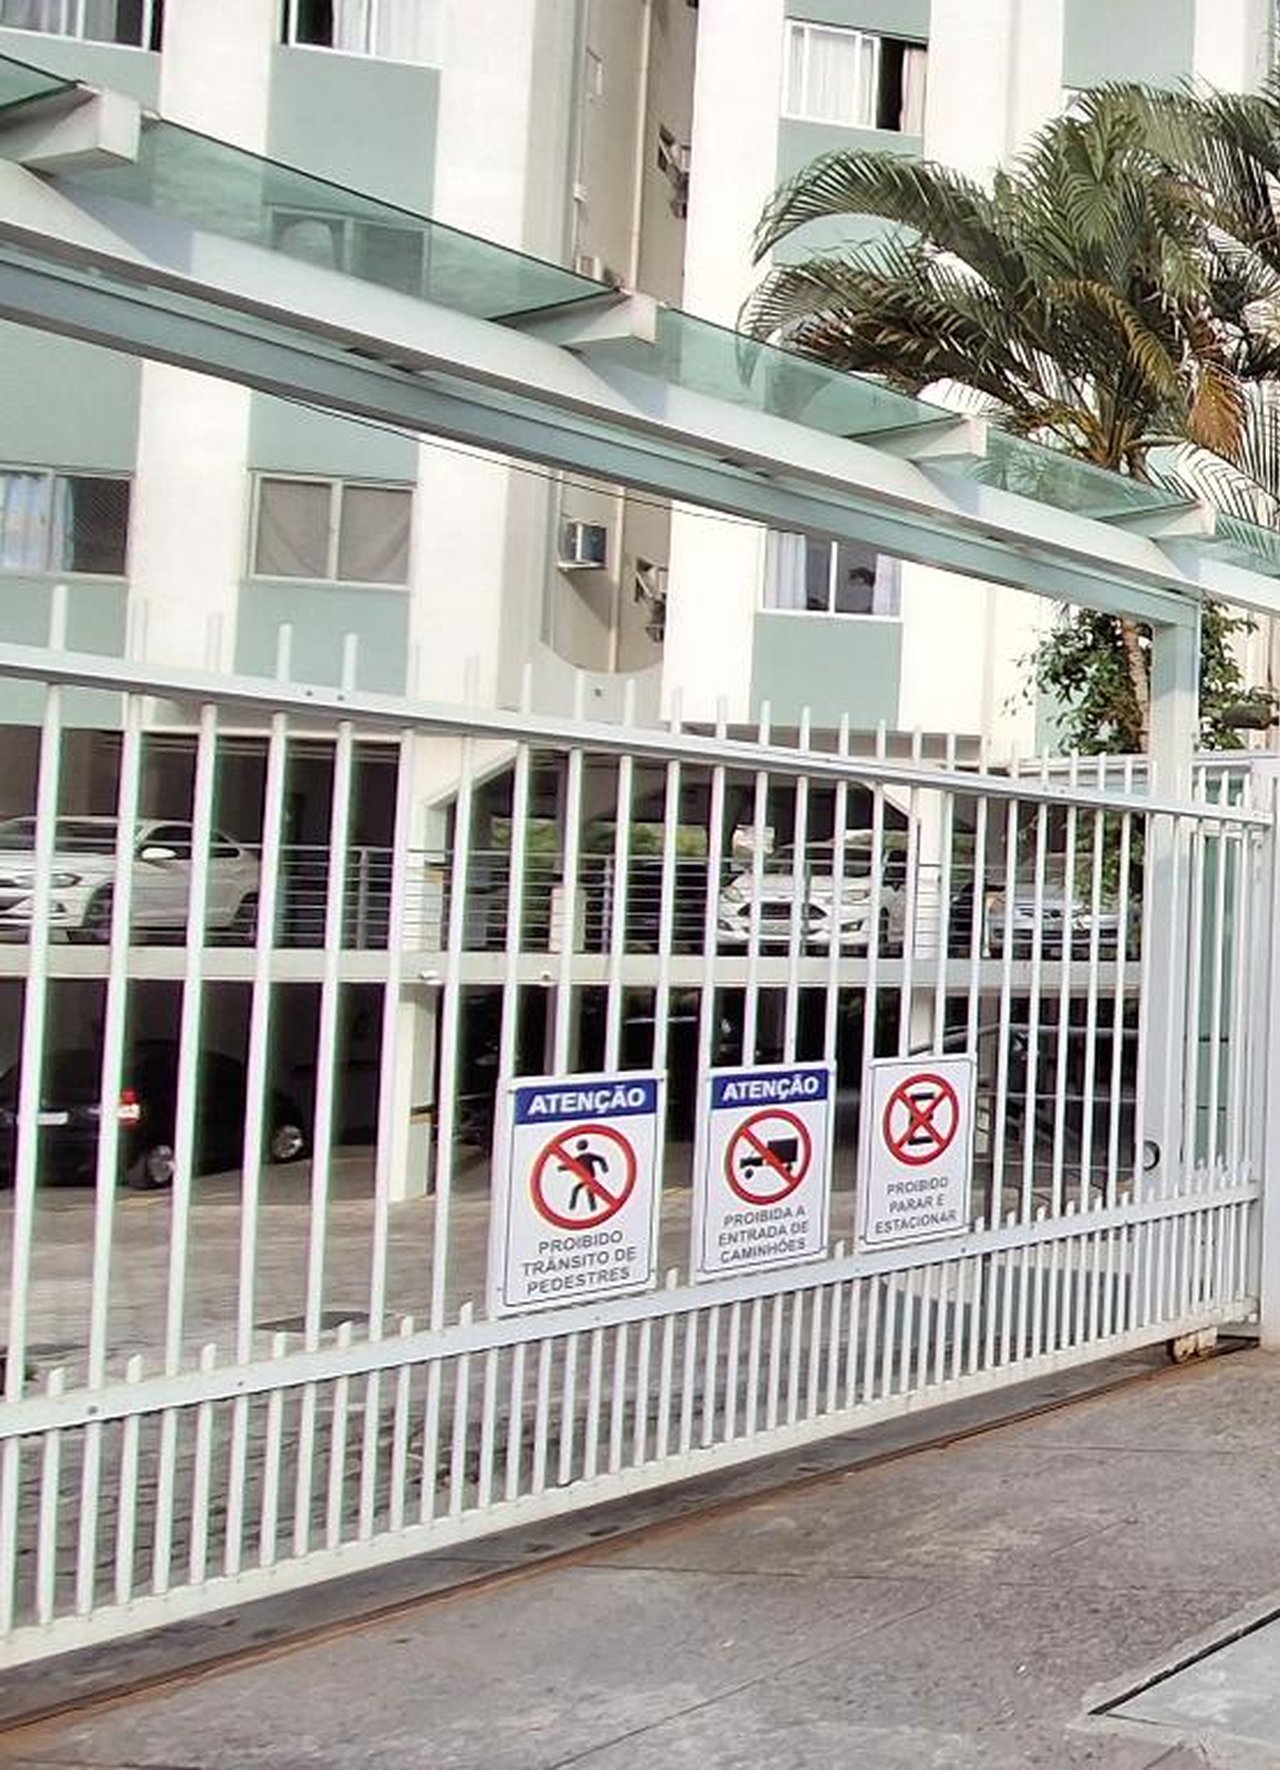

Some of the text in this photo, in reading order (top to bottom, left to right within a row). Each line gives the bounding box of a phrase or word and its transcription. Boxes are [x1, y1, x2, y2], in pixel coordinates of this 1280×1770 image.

[527, 1085, 647, 1115] ATENÇÃO
[723, 1075, 819, 1100] ATENÇÃO
[887, 1177, 949, 1195] PROIBIDO
[723, 1205, 806, 1227] PROIBIDA A
[889, 1193, 944, 1213] PARAR E
[718, 1219, 809, 1246] ENTRADA DE
[875, 1209, 957, 1235] ESTACIONAR
[538, 1230, 624, 1254] PROIBIDO
[720, 1237, 806, 1264] CAMINHÕES
[522, 1246, 637, 1277] TRÂNSITO DE
[527, 1266, 630, 1296] PEDESTRES
